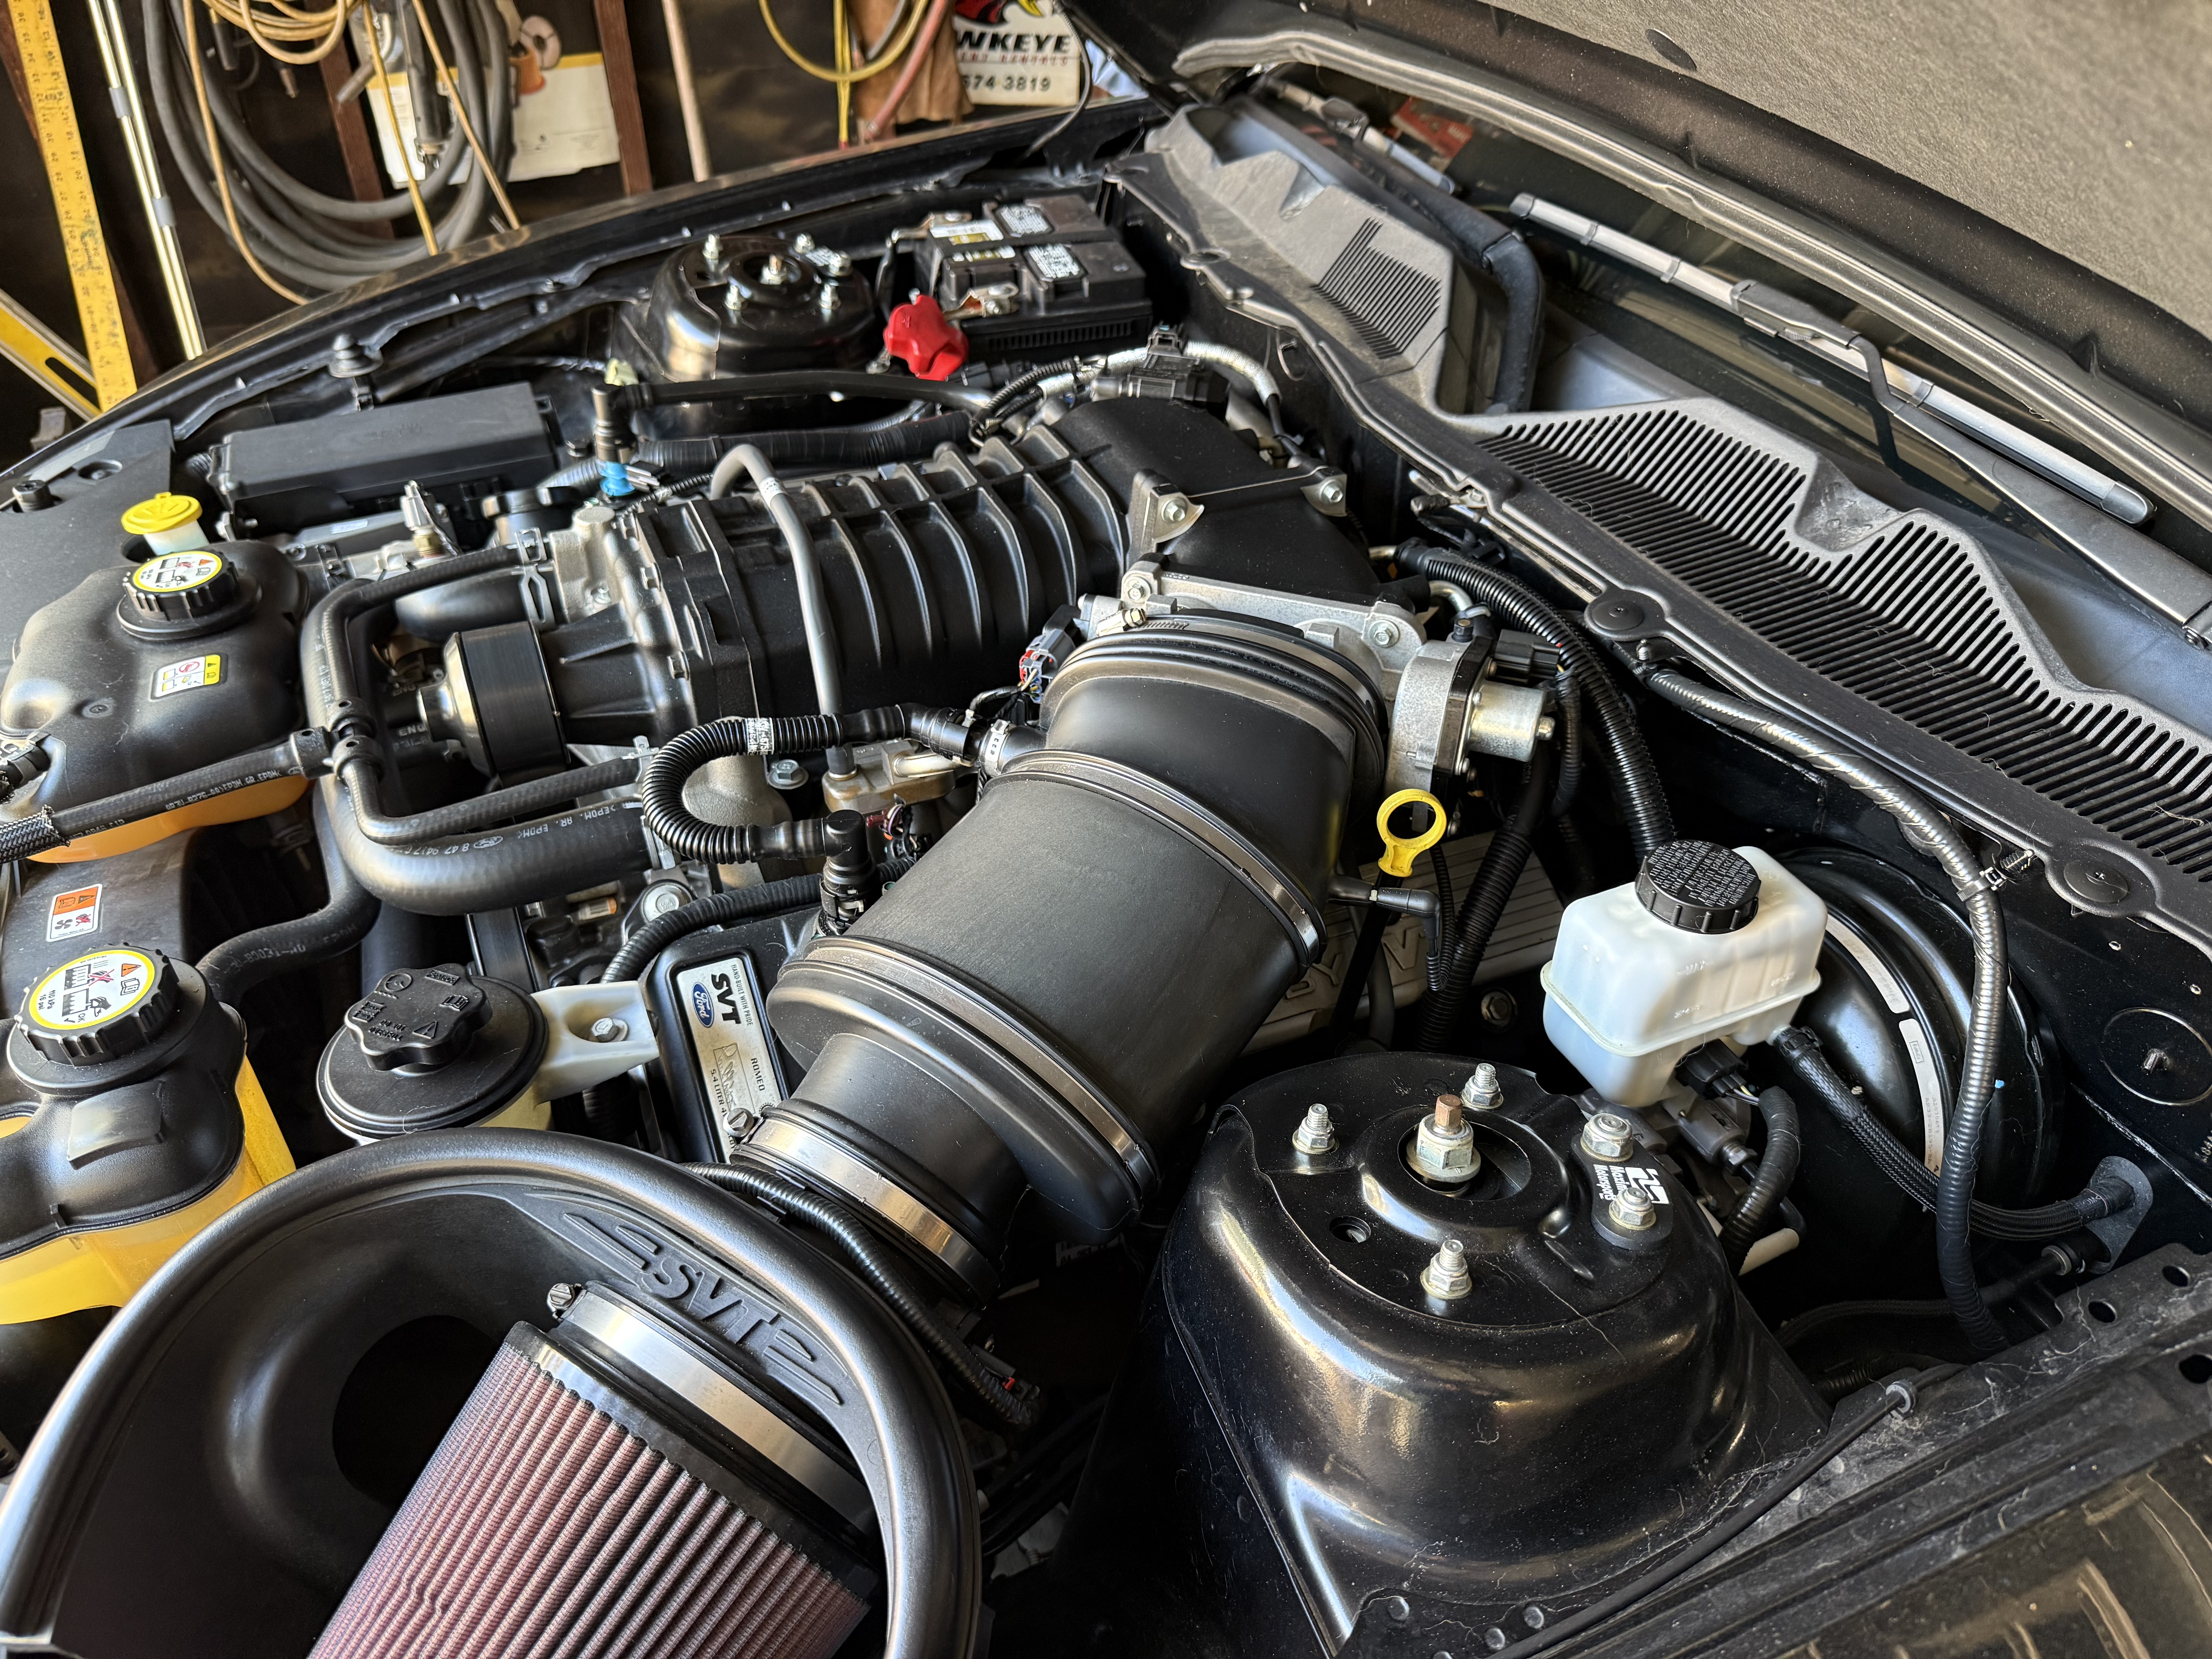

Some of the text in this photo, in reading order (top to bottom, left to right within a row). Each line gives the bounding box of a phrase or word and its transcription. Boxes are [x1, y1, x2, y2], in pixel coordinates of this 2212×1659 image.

[956, 31, 1072, 53] WKEYE
[1003, 76, 1051, 93] 3819
[711, 973, 742, 1024] SVT
[731, 964, 753, 1026] HAND-BUILT WITH PRIDE
[77, 1013, 86, 1023] OK
[368, 1026, 403, 1042] OVERFILL
[710, 1069, 719, 1082] 5.4
[750, 1058, 765, 1091] ROMEO
[714, 1084, 725, 1105] LITER
[1593, 1164, 1617, 1201] Motorsports
[640, 1262, 780, 1346] SVT
